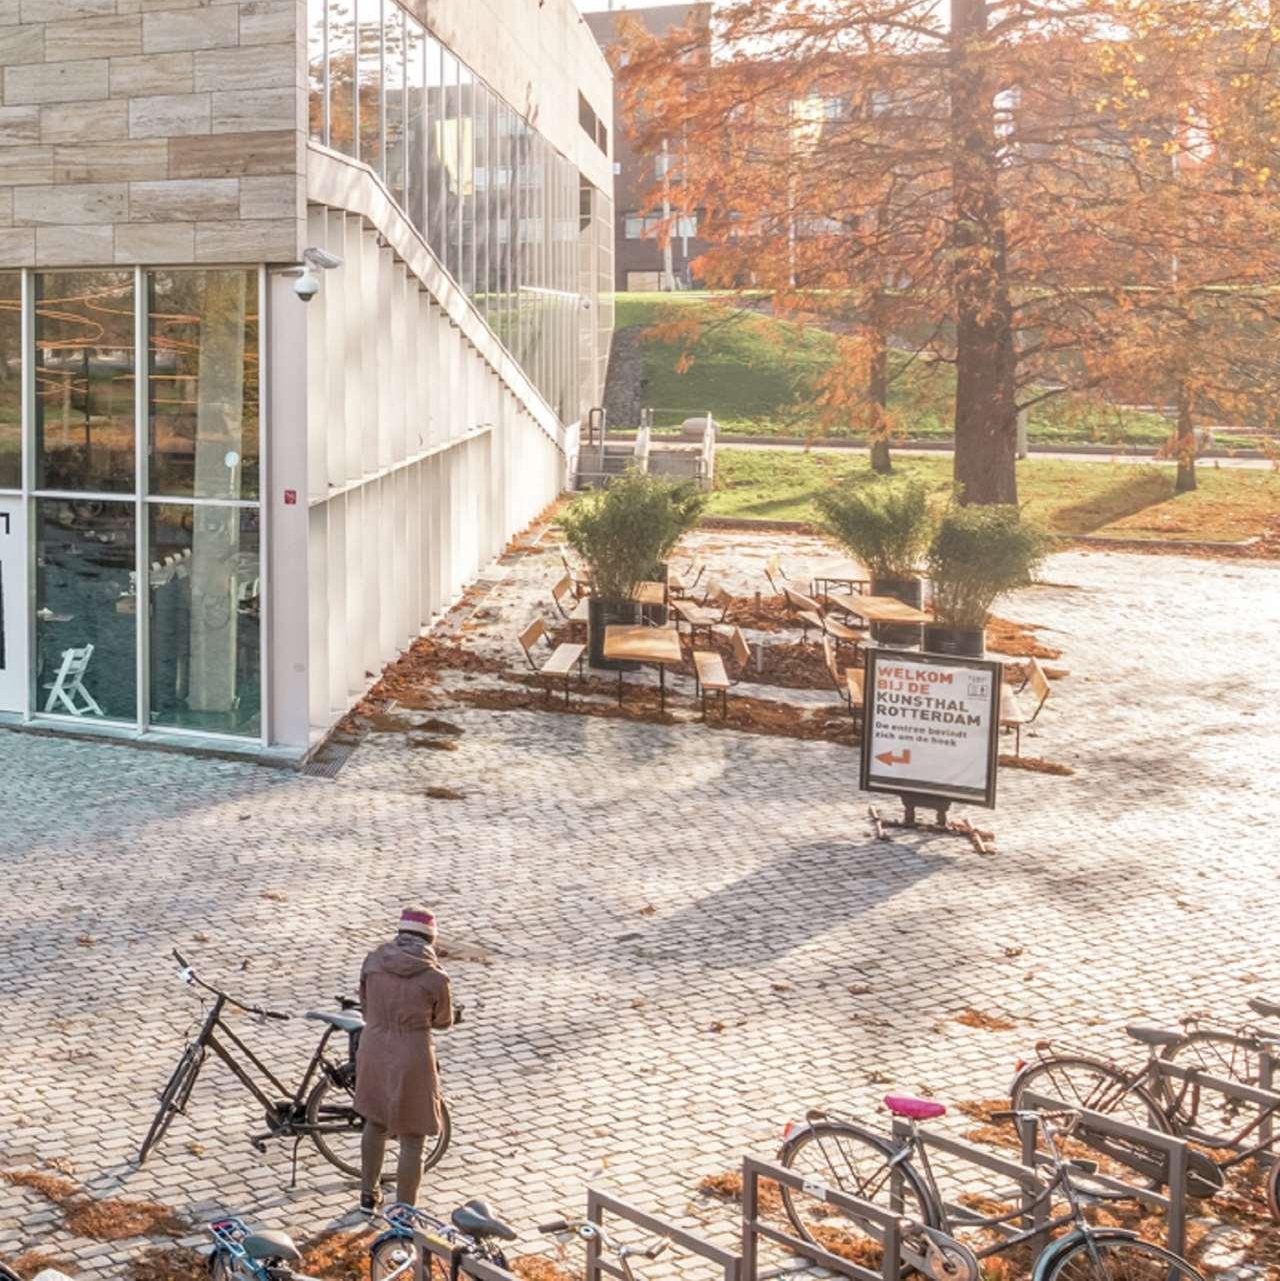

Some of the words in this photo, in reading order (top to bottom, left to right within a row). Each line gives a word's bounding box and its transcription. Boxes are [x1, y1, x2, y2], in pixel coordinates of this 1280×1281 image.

[878, 666, 954, 685] WELKOM
[877, 679, 903, 692] BIJ
[908, 682, 930, 695] DE
[877, 691, 969, 713] KUNSTHAL
[876, 704, 981, 726] ROTTERDAM
[875, 721, 889, 730] De
[928, 726, 968, 739] bevindt
[875, 731, 896, 740] zich
[916, 734, 930, 744] de
[930, 736, 958, 747] hoek
